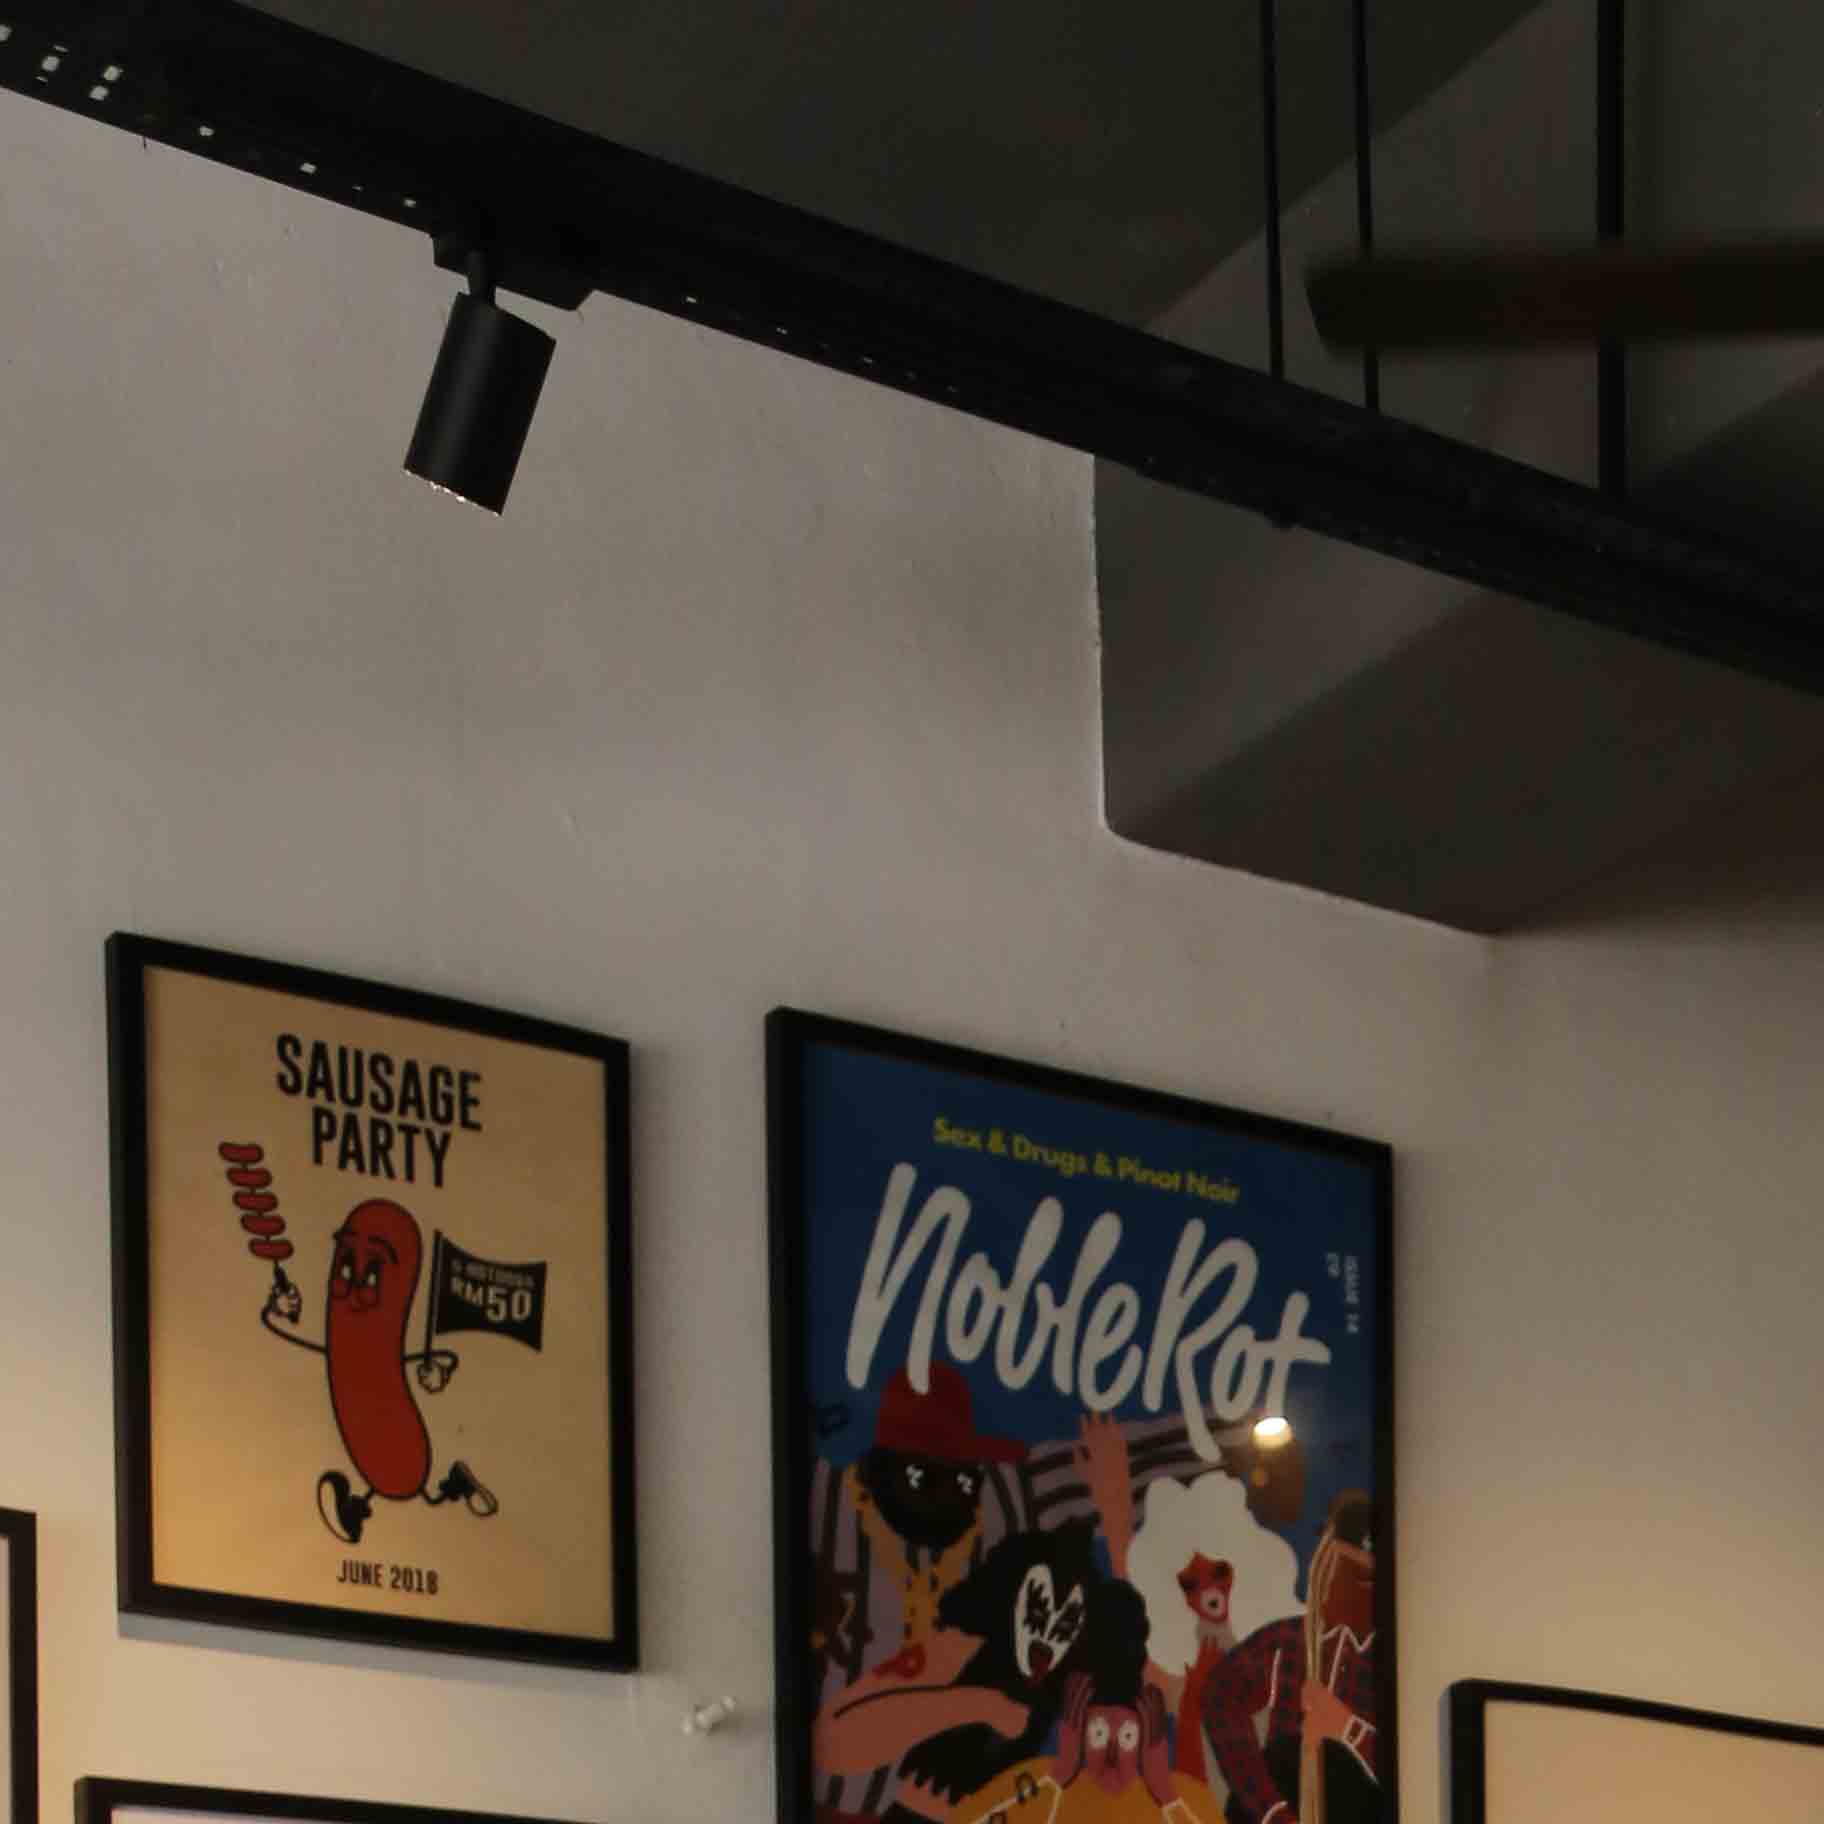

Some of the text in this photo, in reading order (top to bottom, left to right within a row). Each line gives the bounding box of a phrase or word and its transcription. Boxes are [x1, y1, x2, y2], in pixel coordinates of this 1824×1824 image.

[276, 1034, 482, 1132] SAUSAGE
[311, 1106, 451, 1188] PARTY
[933, 1116, 1240, 1206] Sex & Drugs & Pinot Noir
[337, 1558, 440, 1596] JUNE 2018
